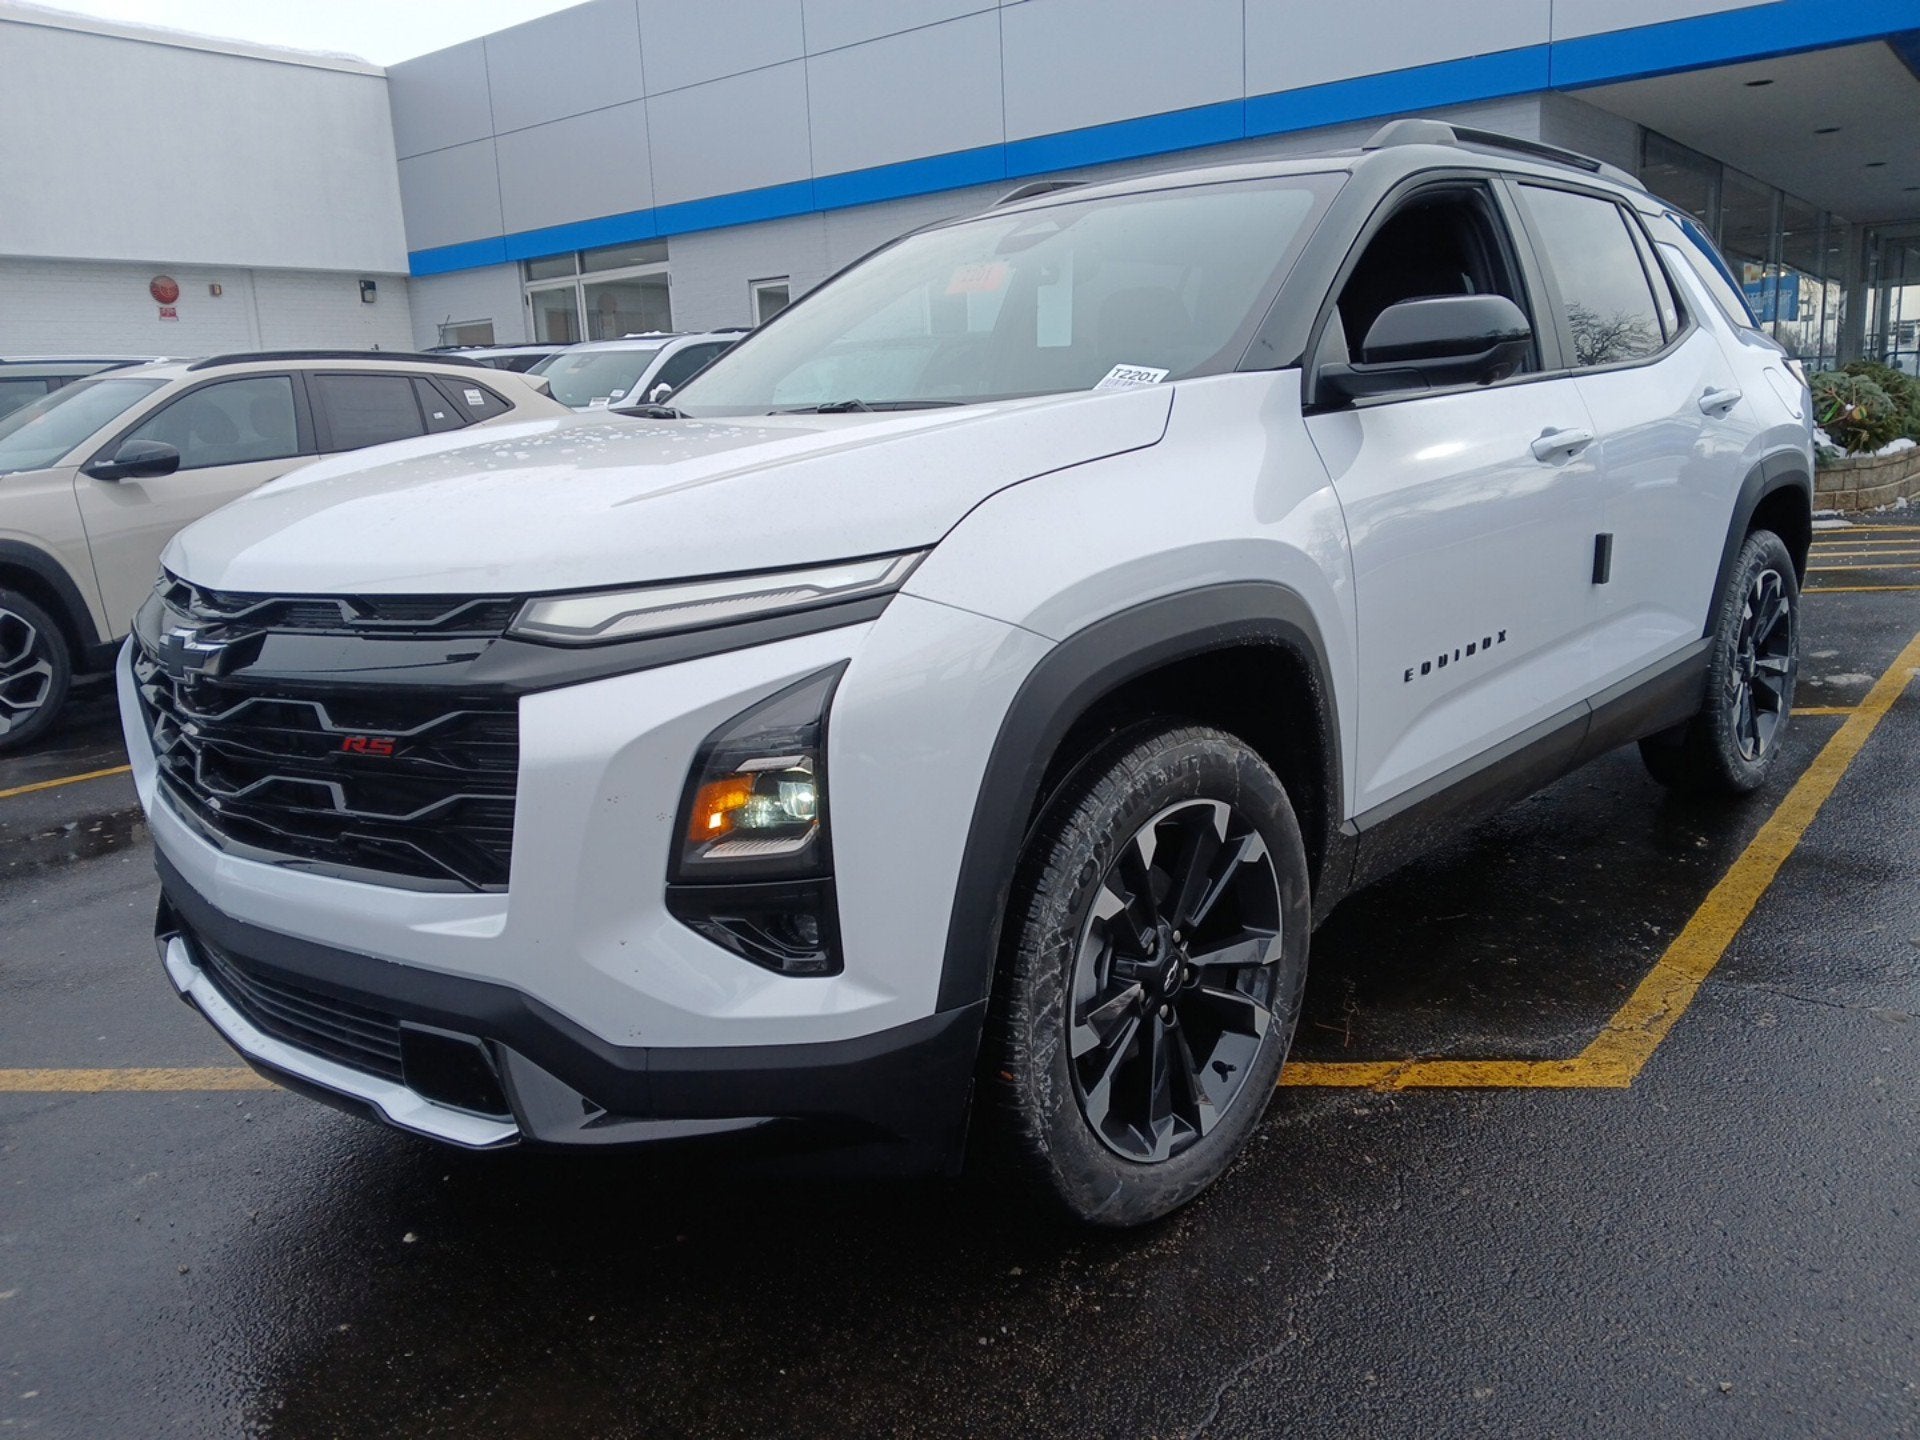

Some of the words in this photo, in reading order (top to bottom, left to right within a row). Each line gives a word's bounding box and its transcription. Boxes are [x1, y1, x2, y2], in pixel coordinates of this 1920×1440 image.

[1111, 367, 1159, 383] T2201
[1403, 629, 1507, 683] EQUINOX
[342, 736, 396, 756] RS
